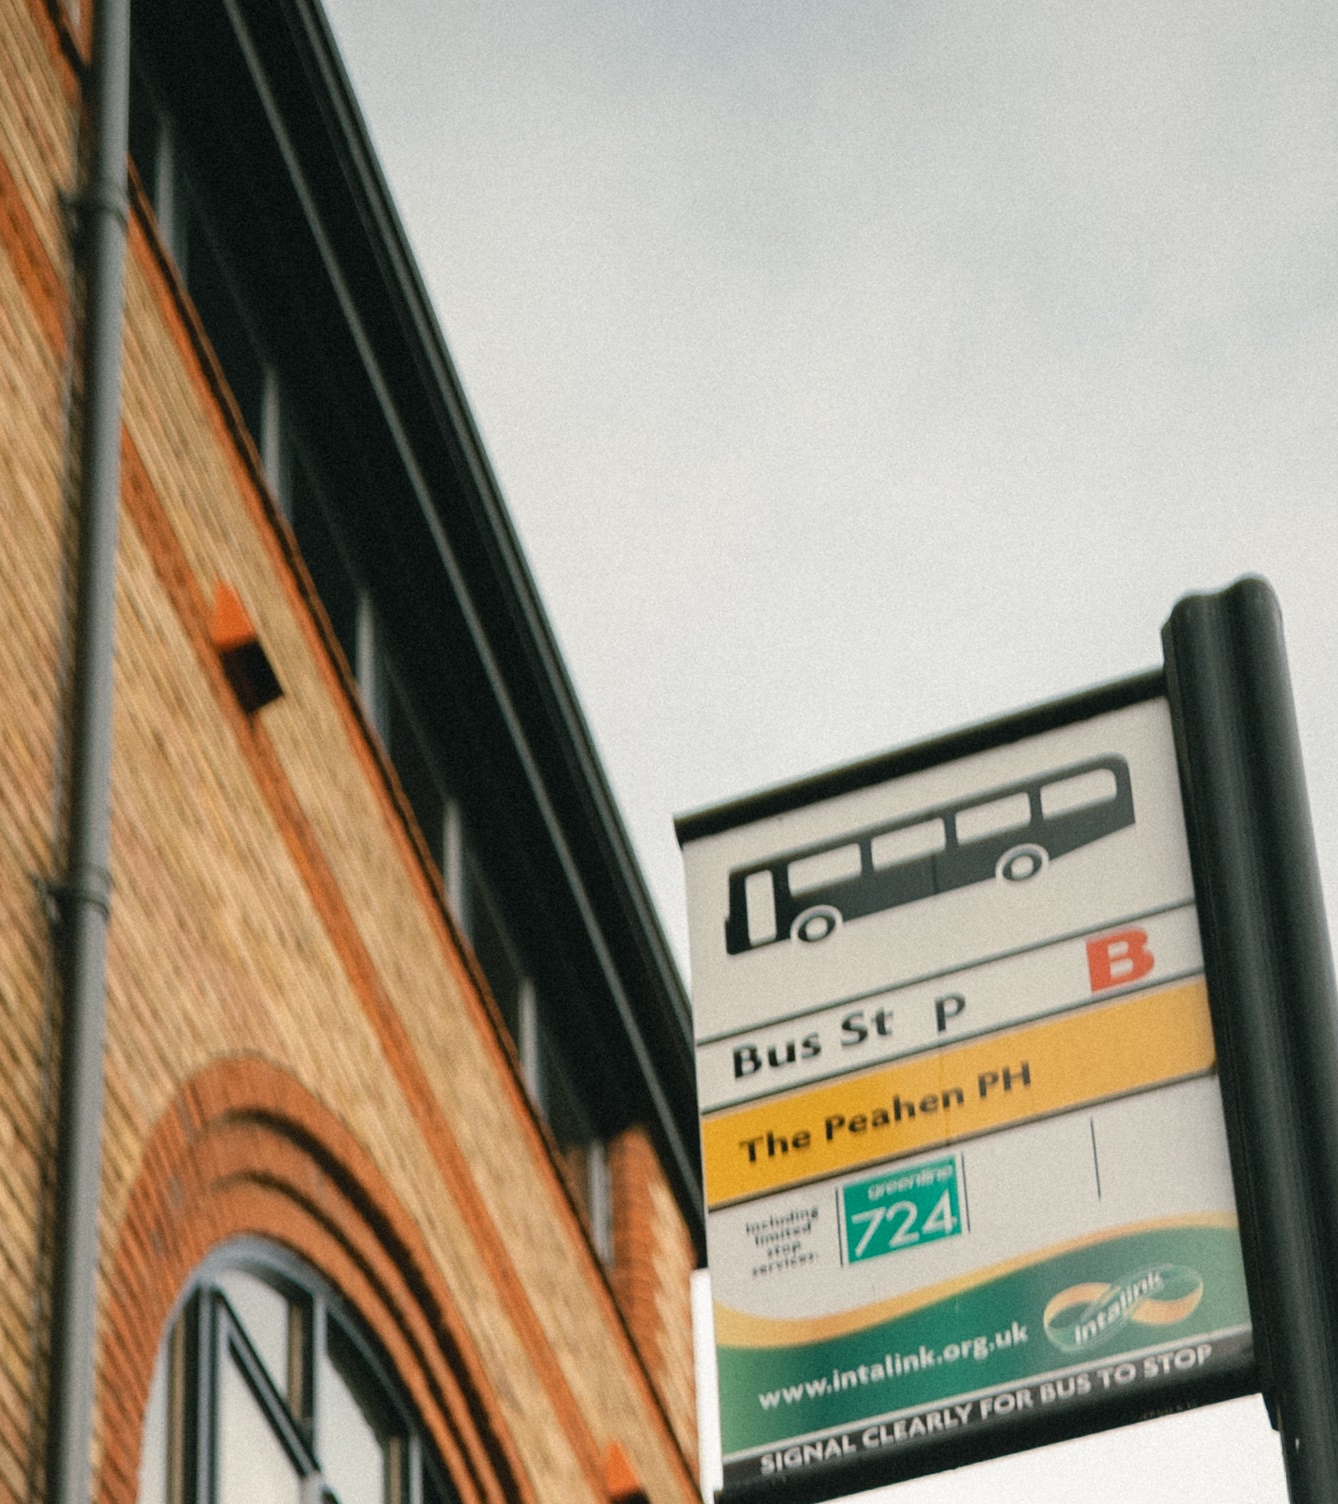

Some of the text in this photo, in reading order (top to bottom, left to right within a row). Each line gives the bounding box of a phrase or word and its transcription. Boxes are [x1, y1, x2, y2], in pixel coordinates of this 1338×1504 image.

[1085, 924, 1156, 994] B
[732, 1031, 822, 1080] Bus
[738, 1060, 1032, 1163] The Peahen PH
[745, 1205, 819, 1234] including
[754, 1219, 812, 1246] limited
[766, 1240, 802, 1258] stop
[850, 1188, 958, 1259] 724
[758, 1320, 1029, 1410] www.intalink.org.uk
[759, 1343, 1213, 1475] SIGNAL CLEARLY FOR BUS TO STOP
